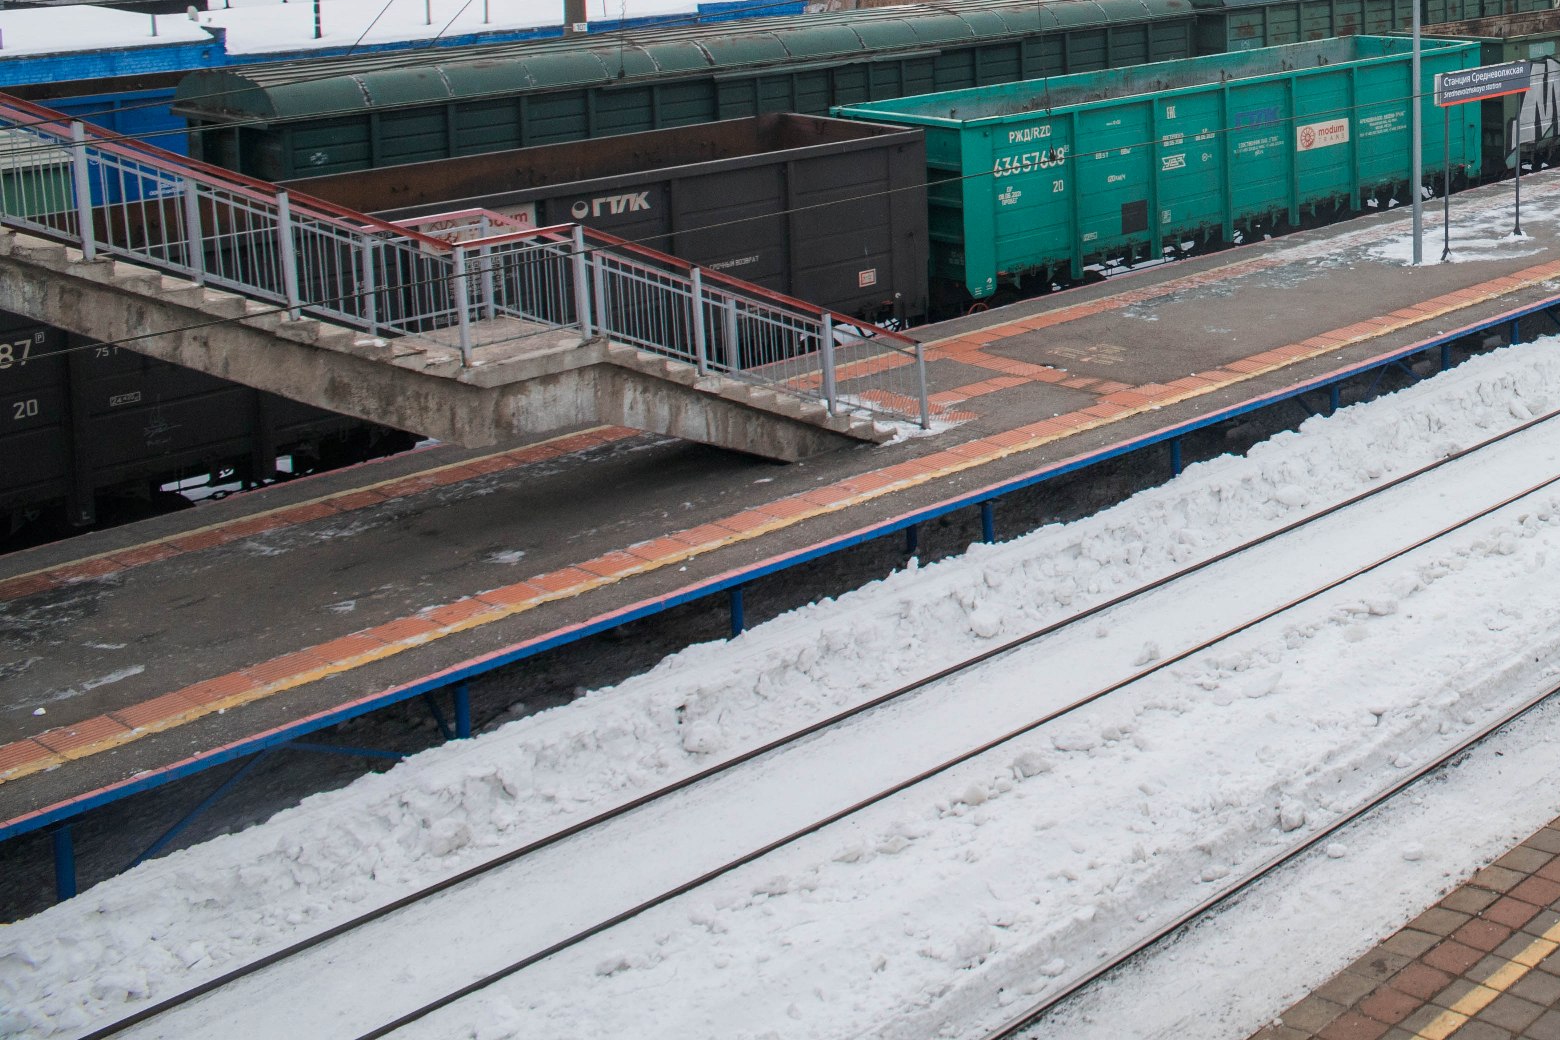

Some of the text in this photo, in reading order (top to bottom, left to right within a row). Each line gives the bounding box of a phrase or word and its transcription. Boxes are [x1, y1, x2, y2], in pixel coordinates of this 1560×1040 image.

[1443, 66, 1524, 87] Станция Средневолжская
[1009, 125, 1052, 143] РЖД/RZD
[1318, 124, 1345, 137] modum
[1052, 179, 1064, 193] 20
[592, 191, 651, 217] ГТЛК
[95, 347, 109, 358] 75
[12, 398, 39, 420] 20
